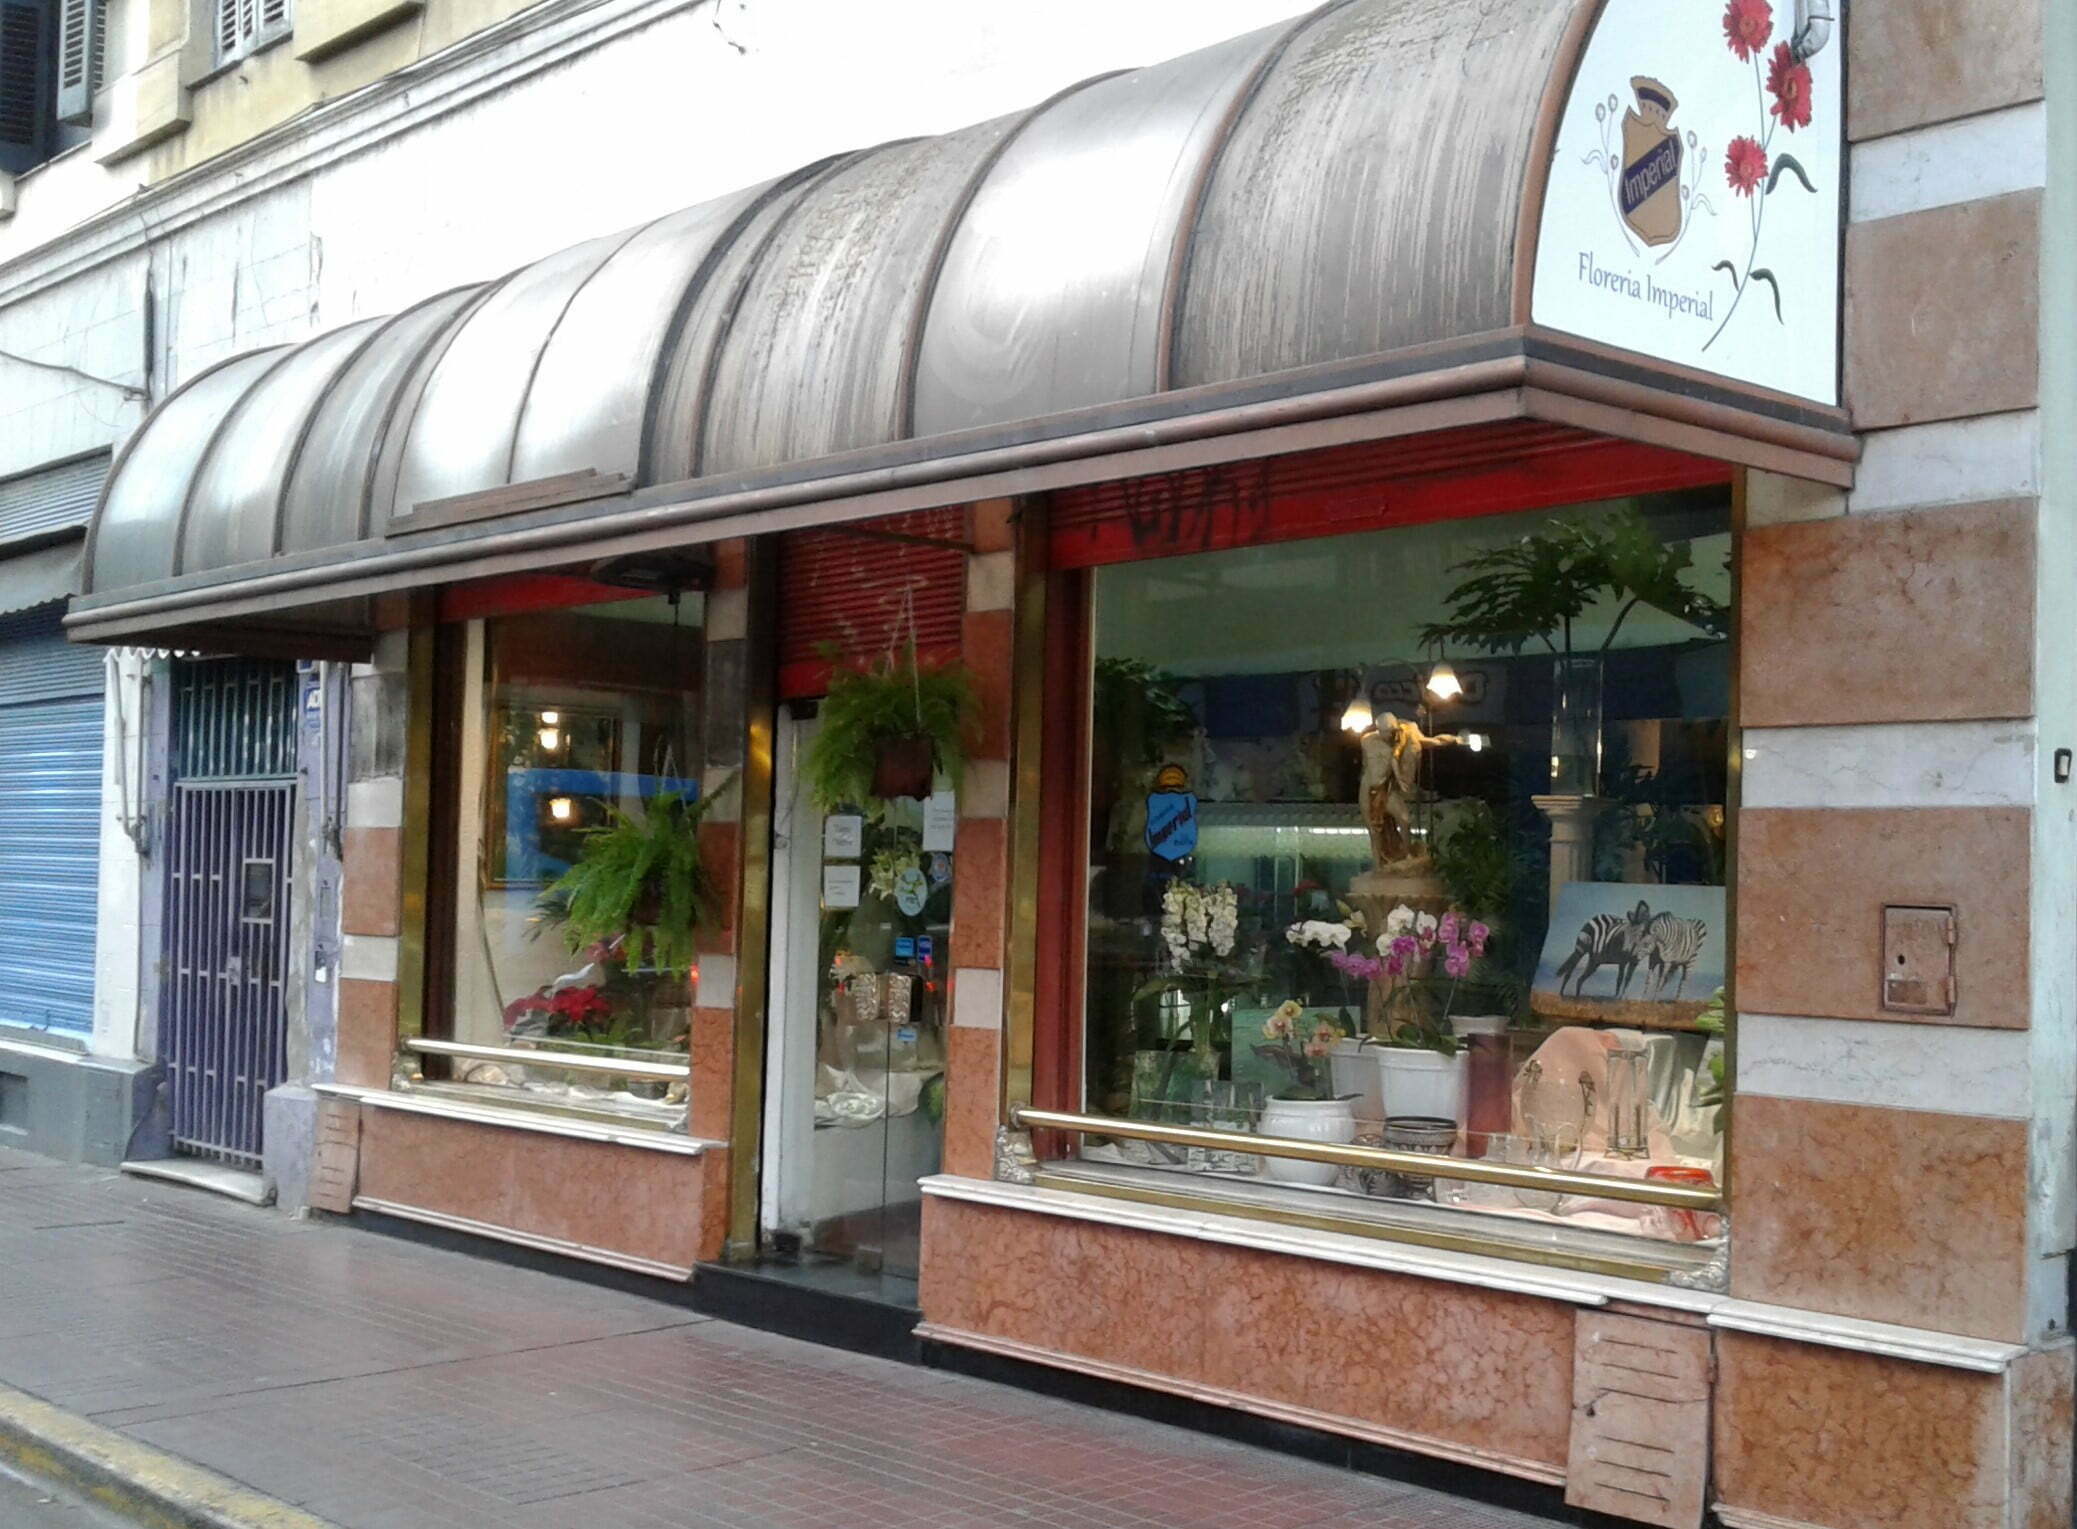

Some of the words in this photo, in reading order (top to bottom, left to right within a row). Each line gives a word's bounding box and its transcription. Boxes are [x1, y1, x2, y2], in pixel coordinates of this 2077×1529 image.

[1624, 139, 1678, 205] Imperial
[1578, 251, 1642, 300] Floreria
[1646, 274, 1713, 321] Imperial
